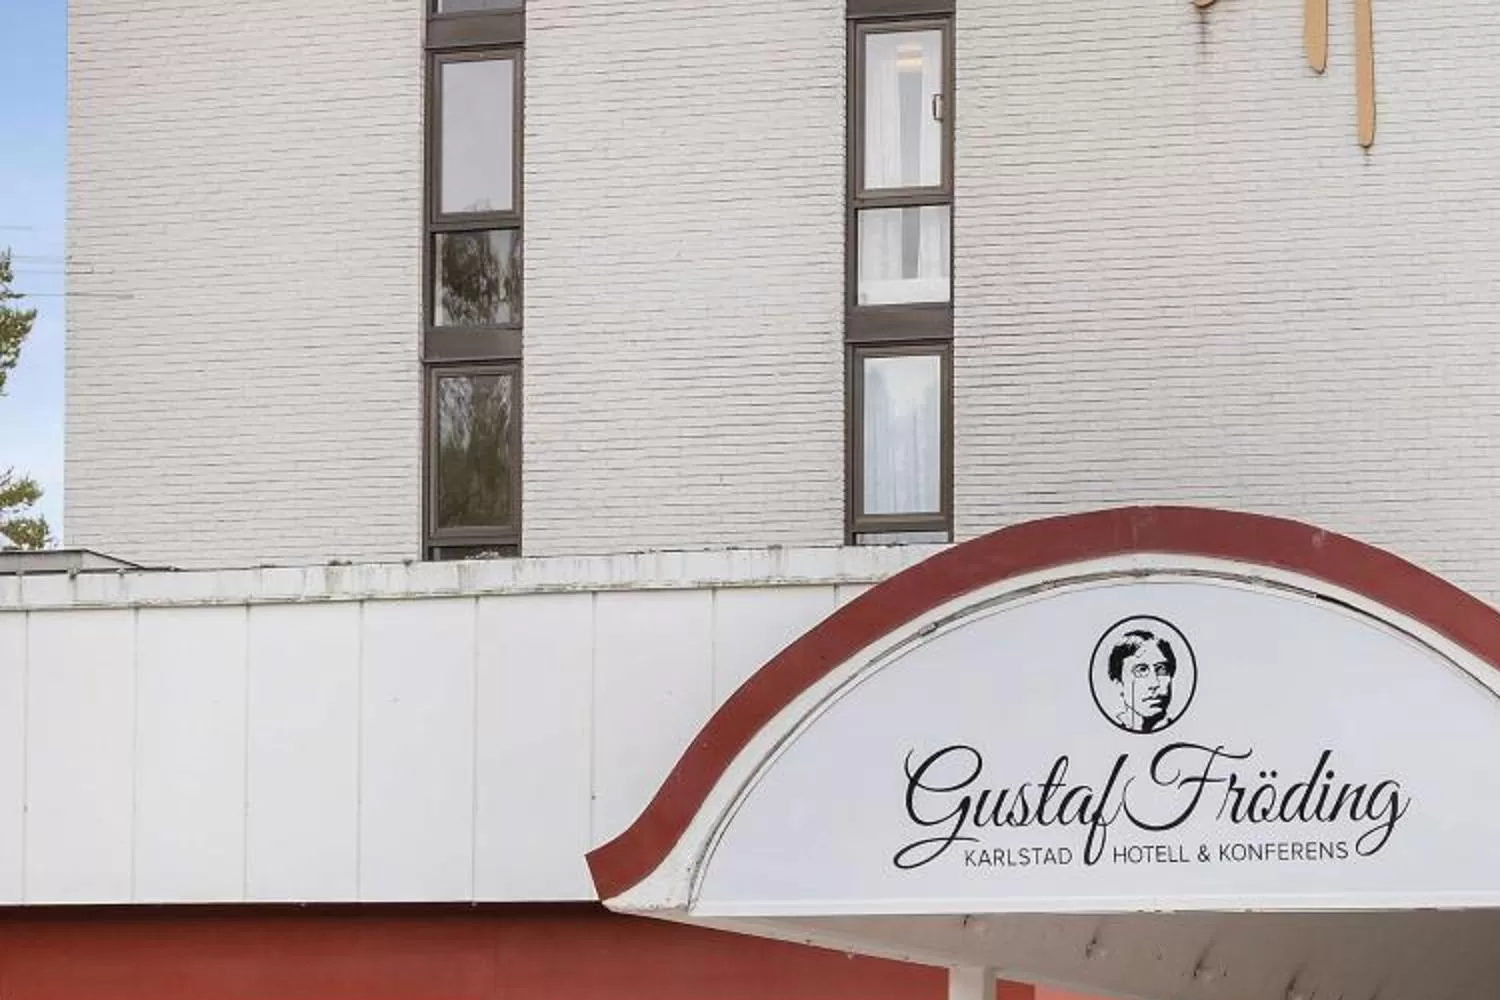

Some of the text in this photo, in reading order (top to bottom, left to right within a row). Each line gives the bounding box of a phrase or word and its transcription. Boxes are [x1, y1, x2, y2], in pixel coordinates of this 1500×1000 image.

[893, 742, 1411, 869] Gustaf Fröding
[964, 841, 1349, 867] KARLSTAD HOTELL & KONFERENS
